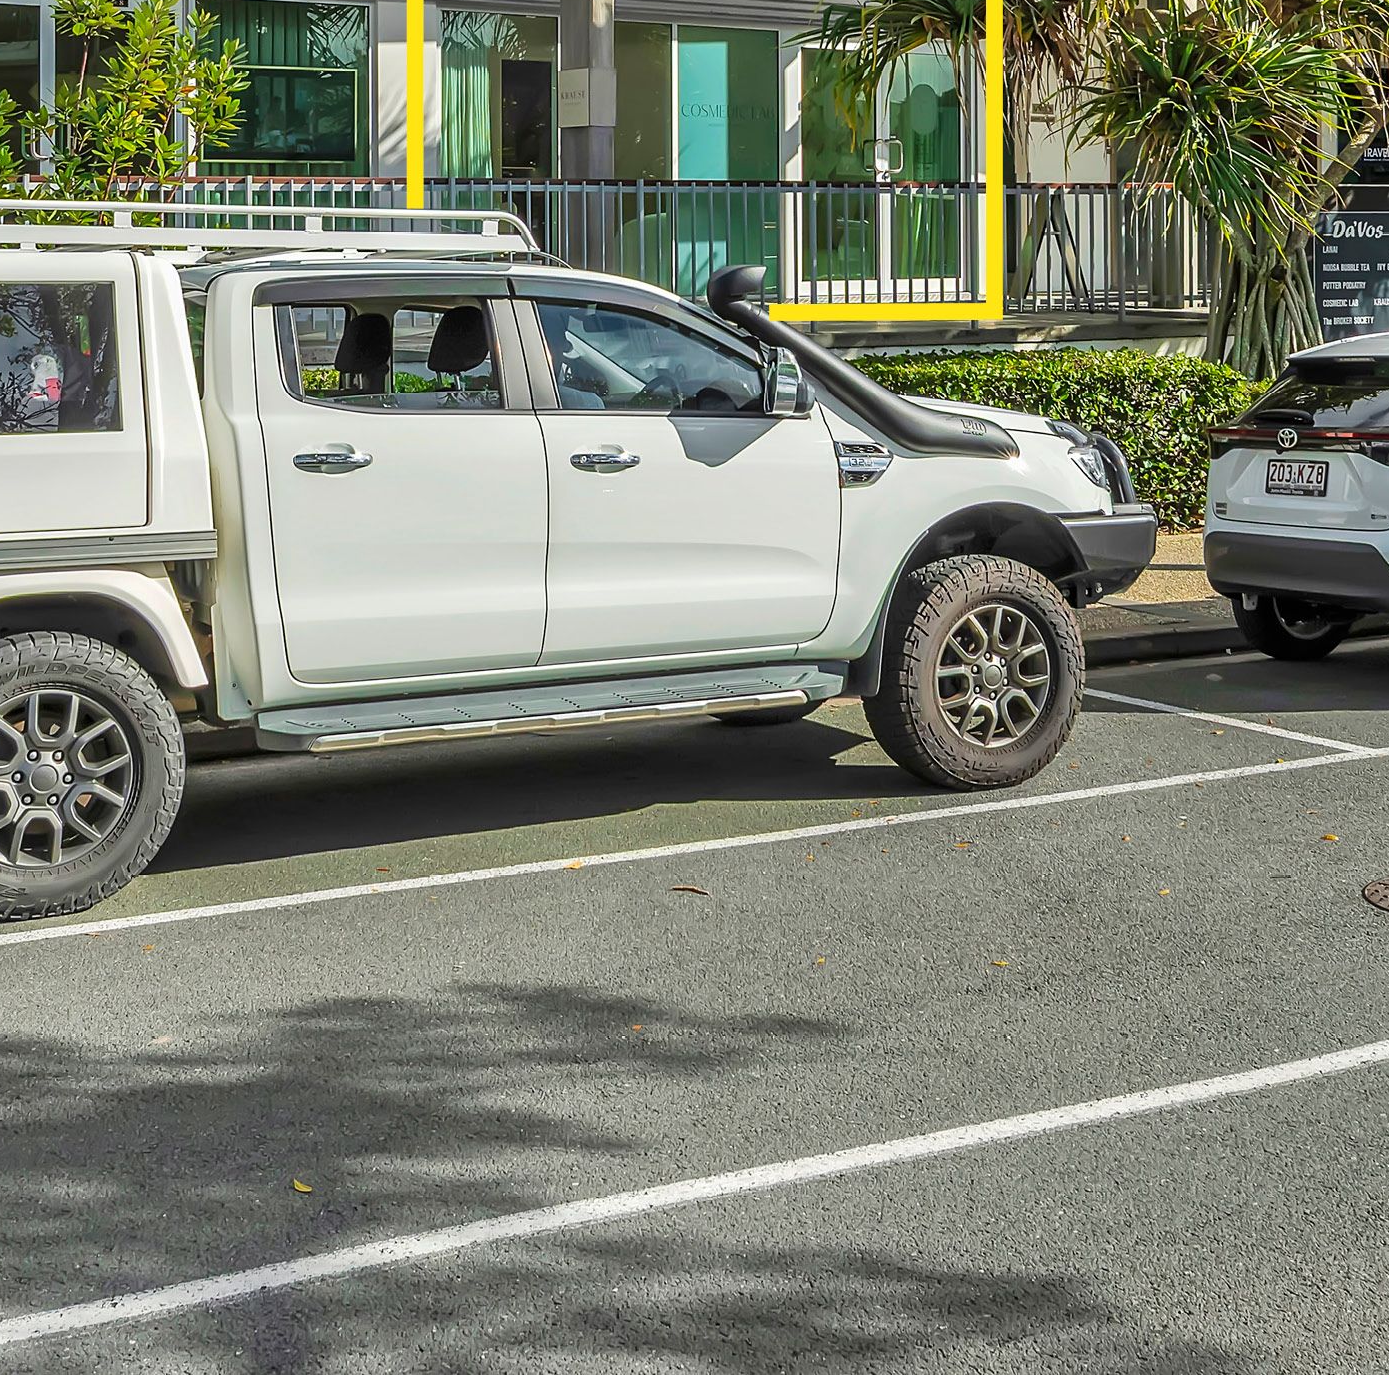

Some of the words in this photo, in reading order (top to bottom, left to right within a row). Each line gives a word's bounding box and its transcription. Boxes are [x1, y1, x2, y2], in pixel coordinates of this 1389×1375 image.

[1360, 263, 1370, 272] TEA
[1322, 281, 1342, 290] POTTER
[1348, 298, 1359, 307] LAB
[1353, 316, 1375, 325] SOCIETY
